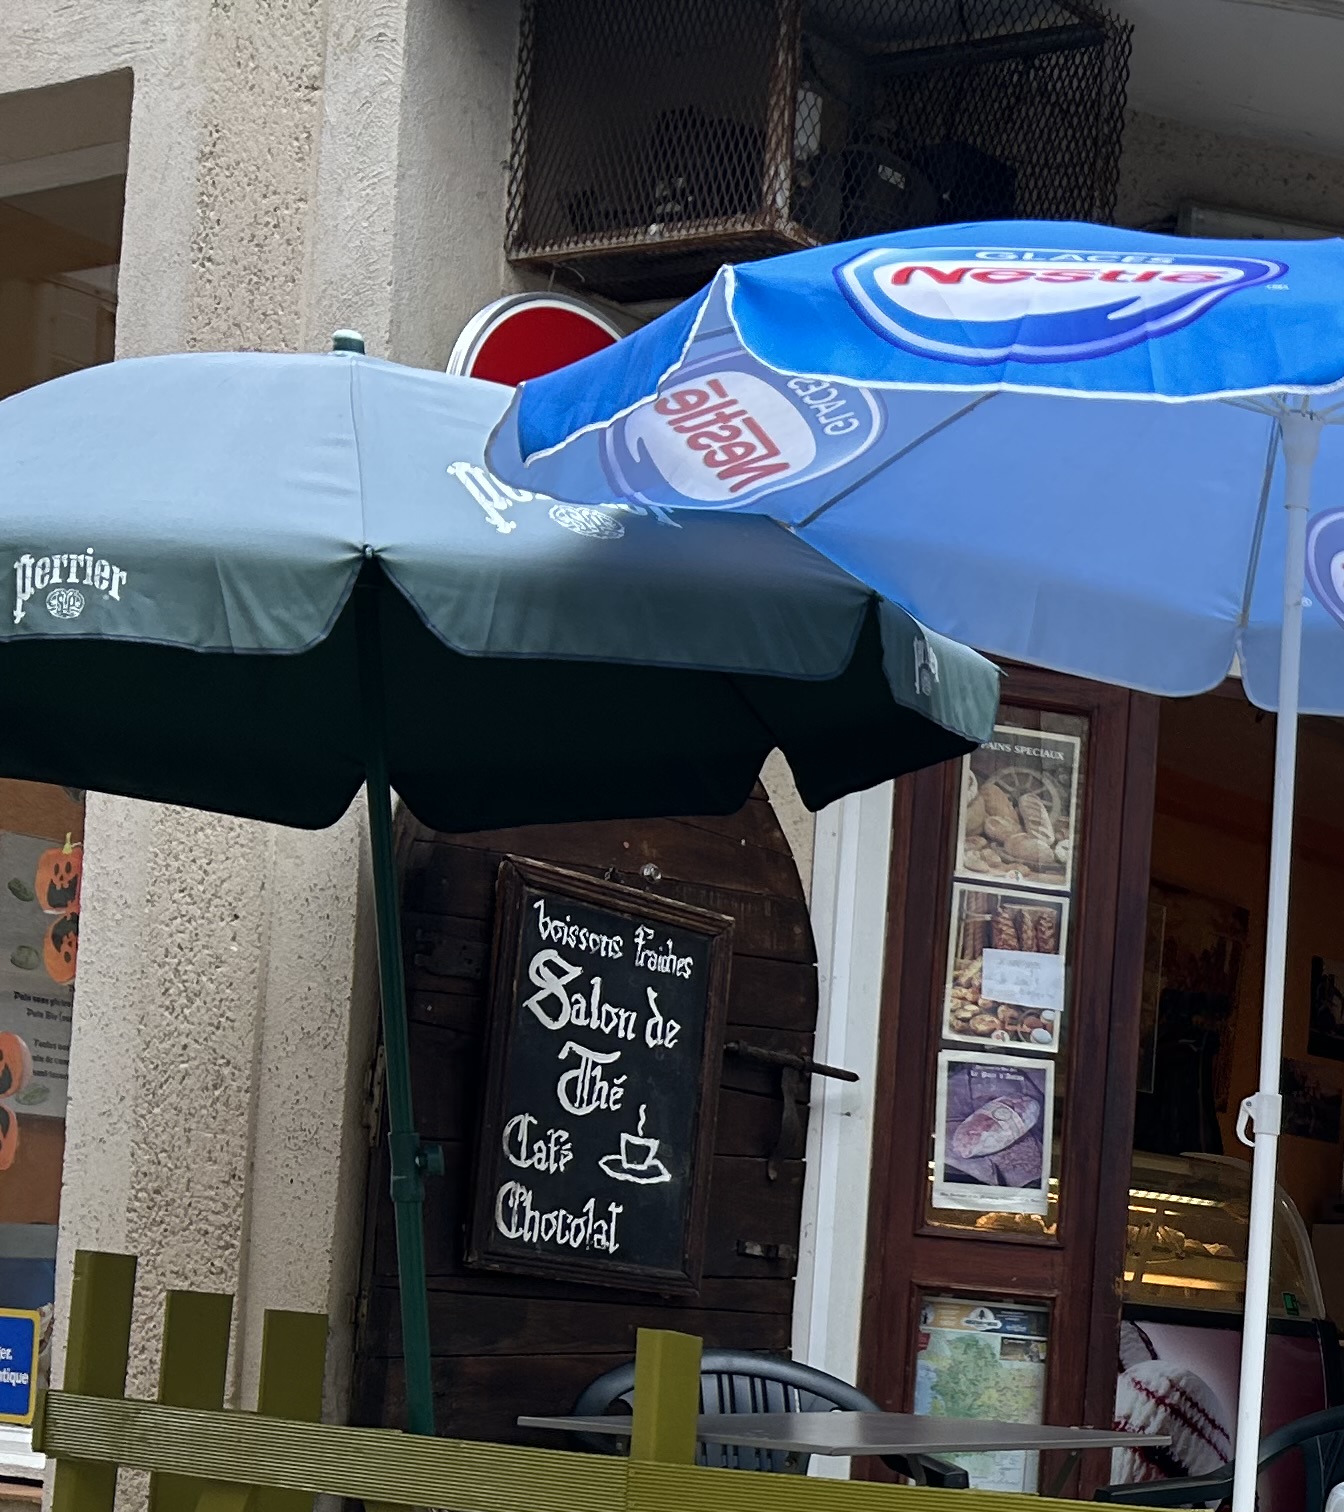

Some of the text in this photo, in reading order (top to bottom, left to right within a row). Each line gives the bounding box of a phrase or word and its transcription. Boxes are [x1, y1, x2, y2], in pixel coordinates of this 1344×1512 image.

[522, 949, 681, 1049] Salon de
[557, 1041, 627, 1116] Thé
[502, 1113, 573, 1174] Café
[494, 1180, 624, 1254] Chocolat
